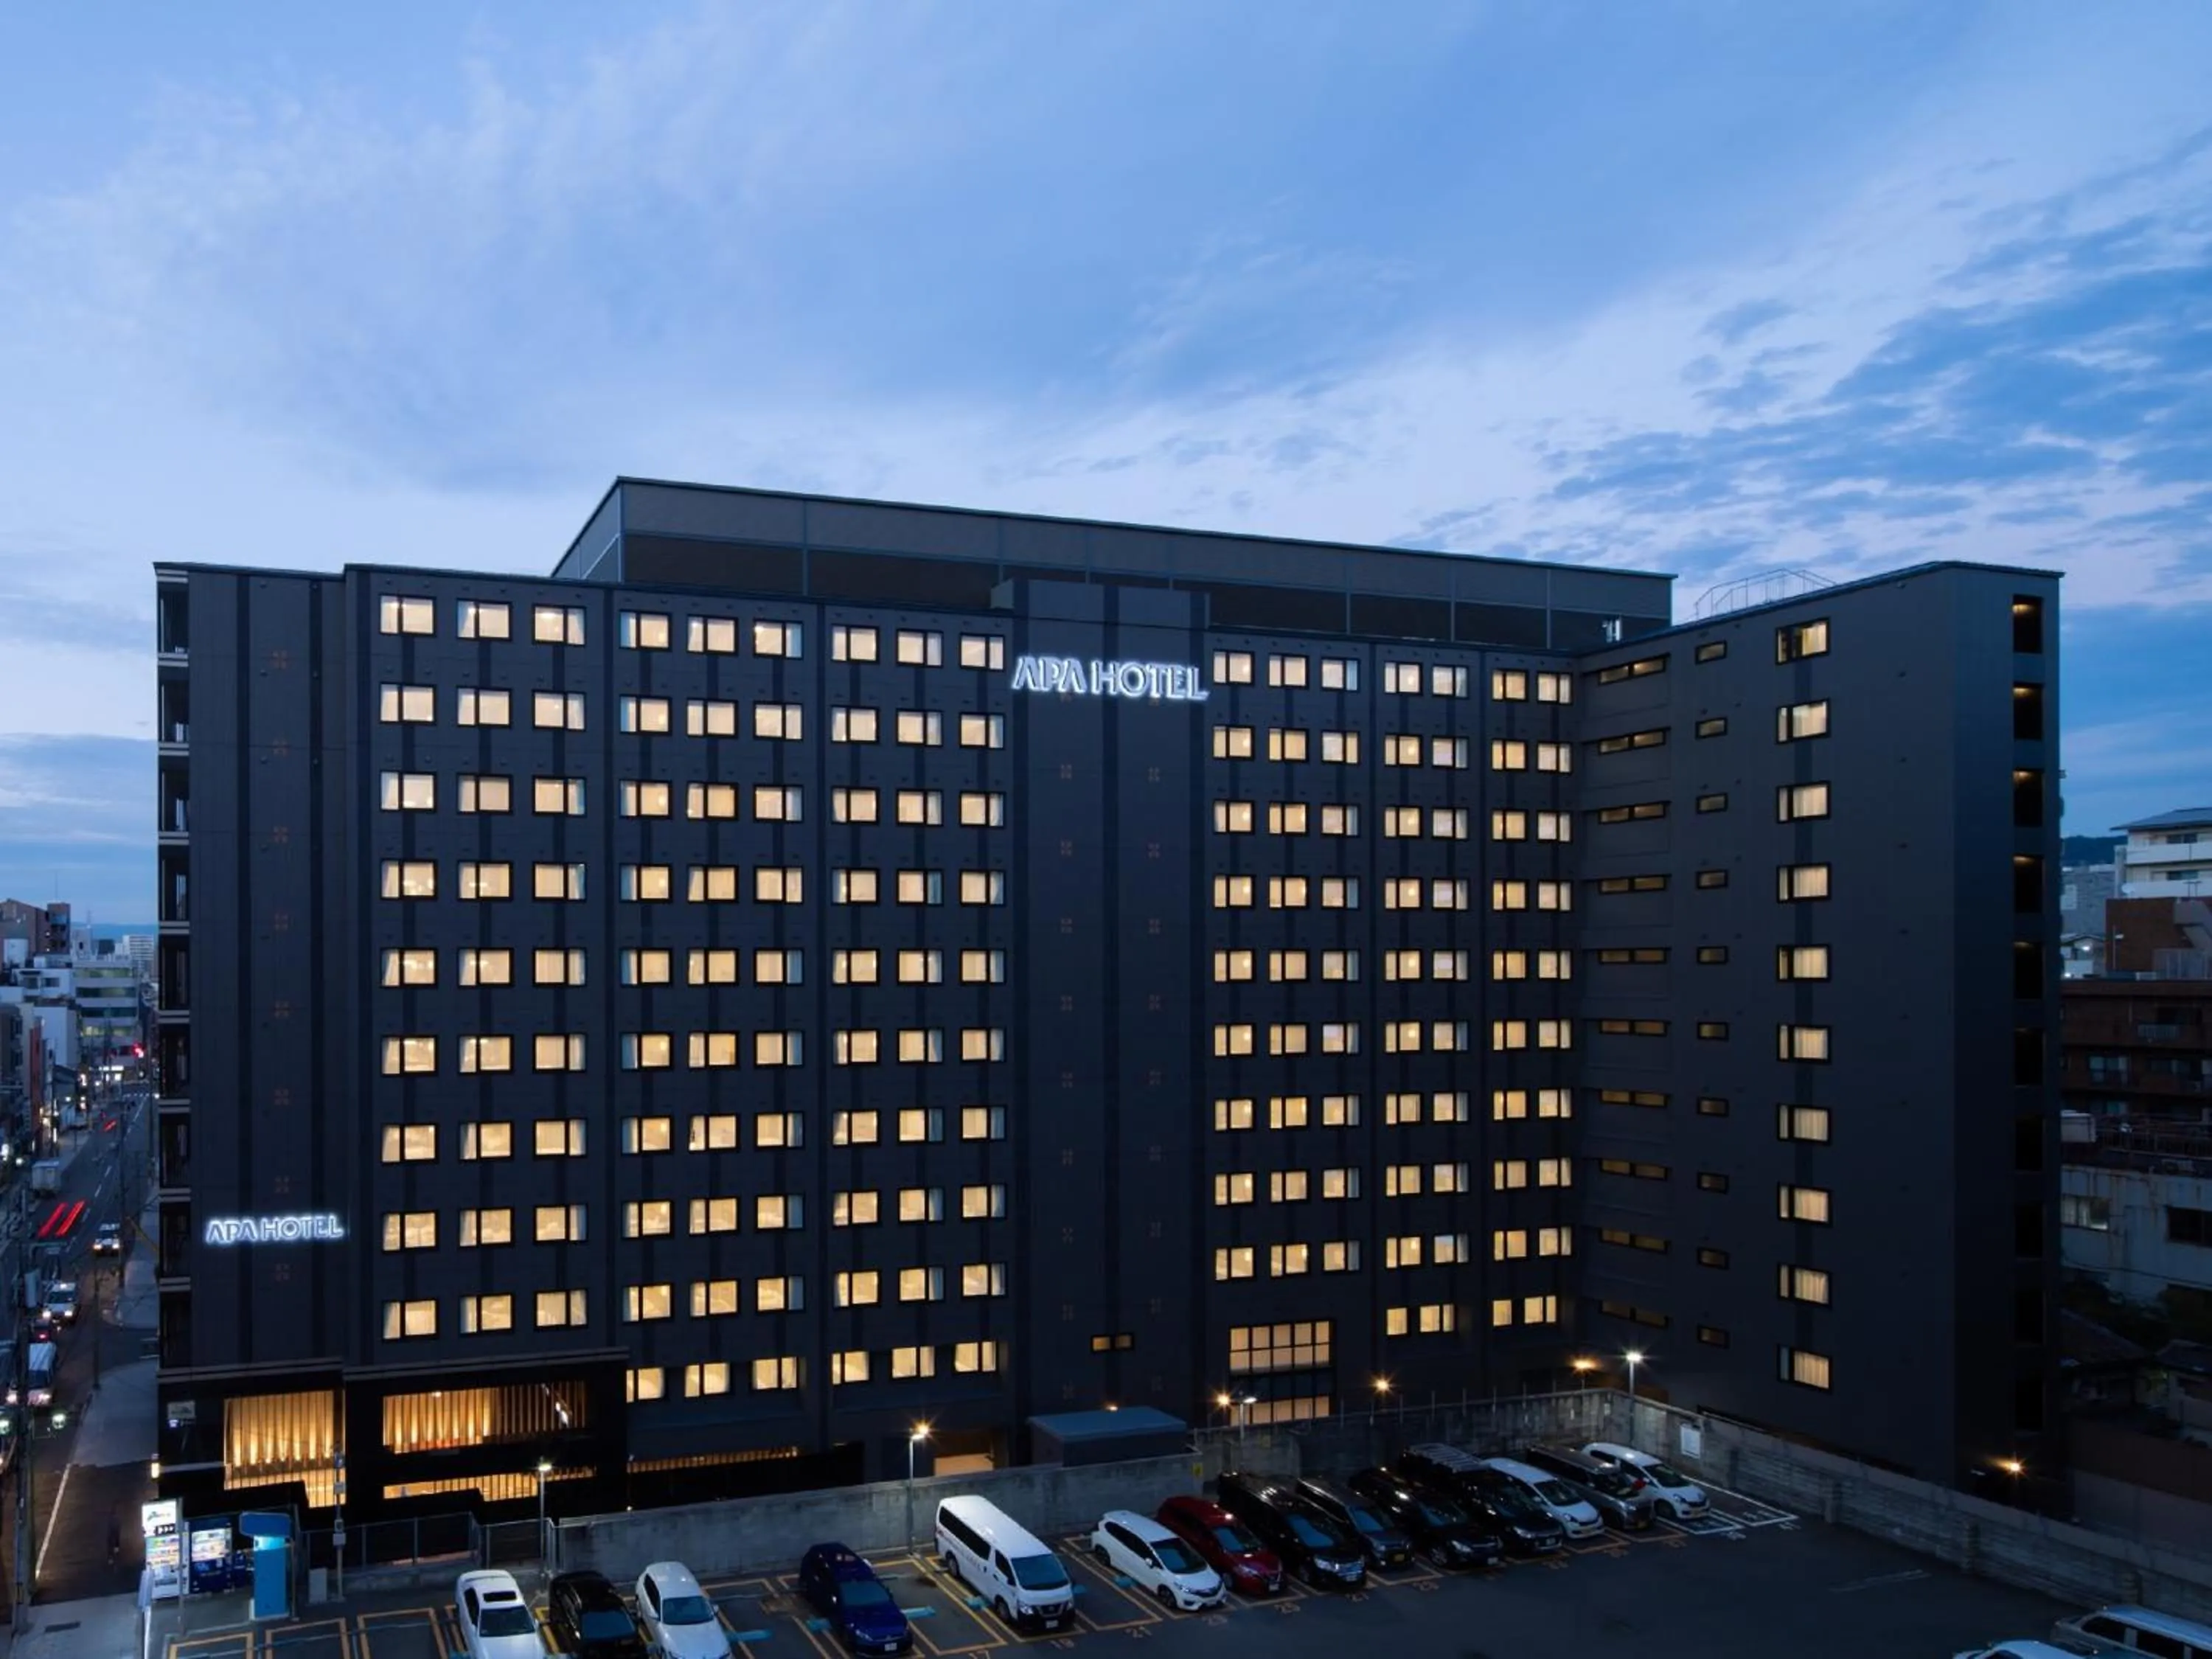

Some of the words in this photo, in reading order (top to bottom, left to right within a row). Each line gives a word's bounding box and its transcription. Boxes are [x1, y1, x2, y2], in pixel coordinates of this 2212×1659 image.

[1011, 655, 1088, 693] APA
[1091, 659, 1211, 700] HOTEL
[205, 1220, 258, 1245] APA
[260, 1214, 344, 1242] HOTEL
